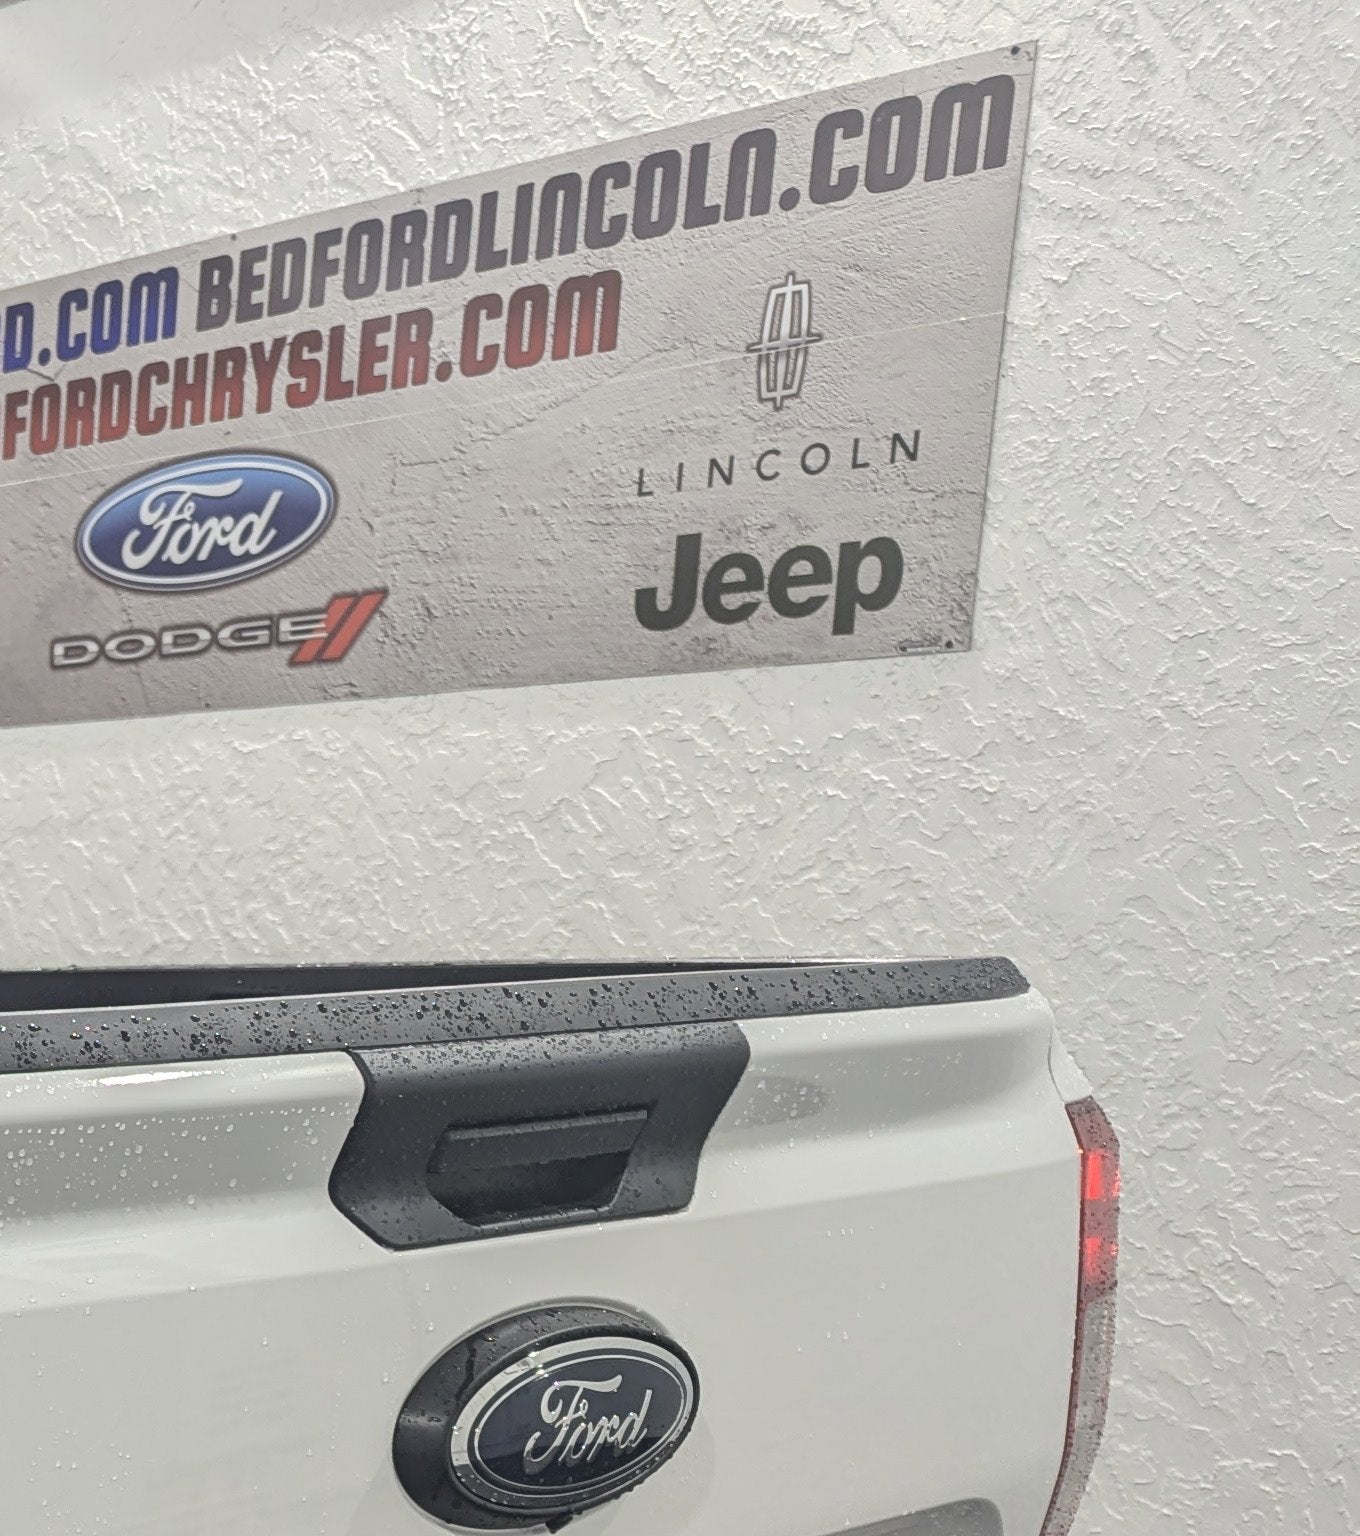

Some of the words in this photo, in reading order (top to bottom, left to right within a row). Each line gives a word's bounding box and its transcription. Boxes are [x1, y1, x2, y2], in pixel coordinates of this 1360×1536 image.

[196, 74, 1016, 332] BEDFORDLINCOLN.COM
[636, 429, 921, 498] LINCOLN
[121, 477, 284, 570] Ford
[634, 532, 905, 636] Jeep
[51, 608, 330, 669] DODGE
[523, 1374, 653, 1464] Ford
